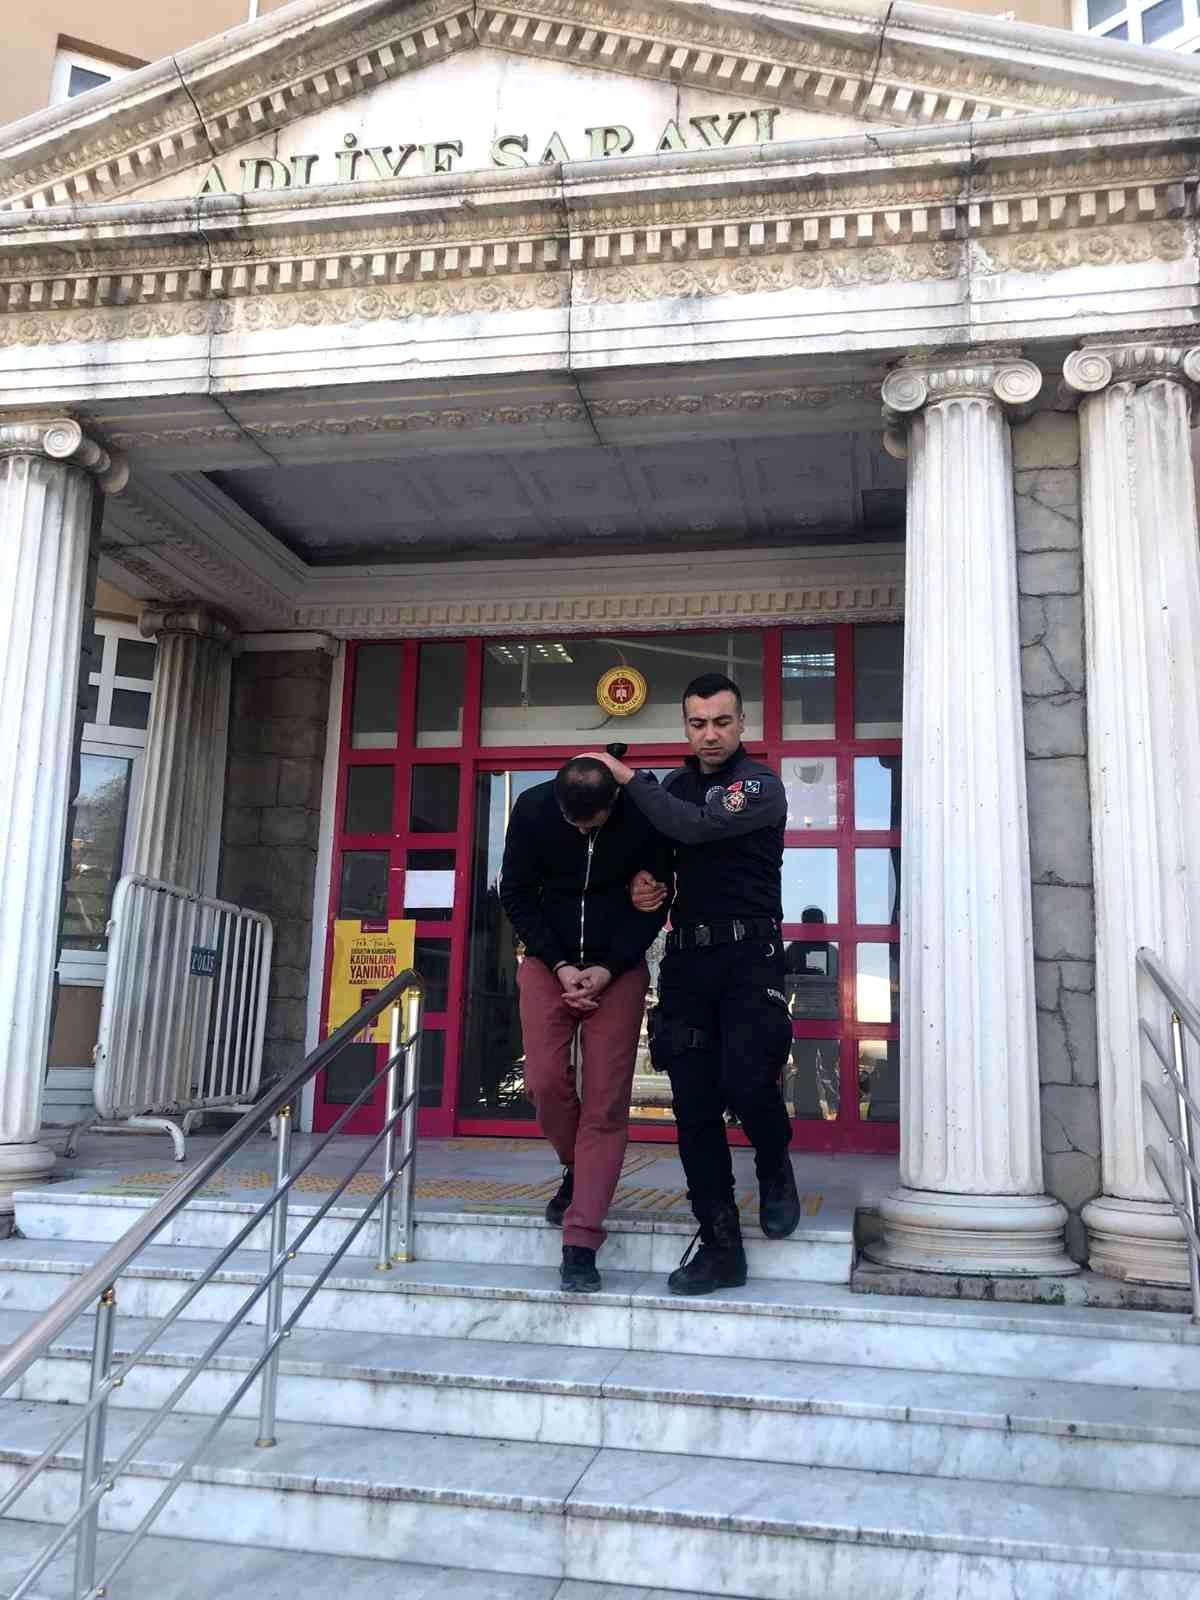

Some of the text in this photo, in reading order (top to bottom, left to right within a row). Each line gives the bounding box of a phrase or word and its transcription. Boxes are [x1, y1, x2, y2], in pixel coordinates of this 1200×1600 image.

[490, 107, 781, 168] SARAYI
[350, 954, 396, 965] KADINLARIN
[350, 965, 395, 979] YANINDA
